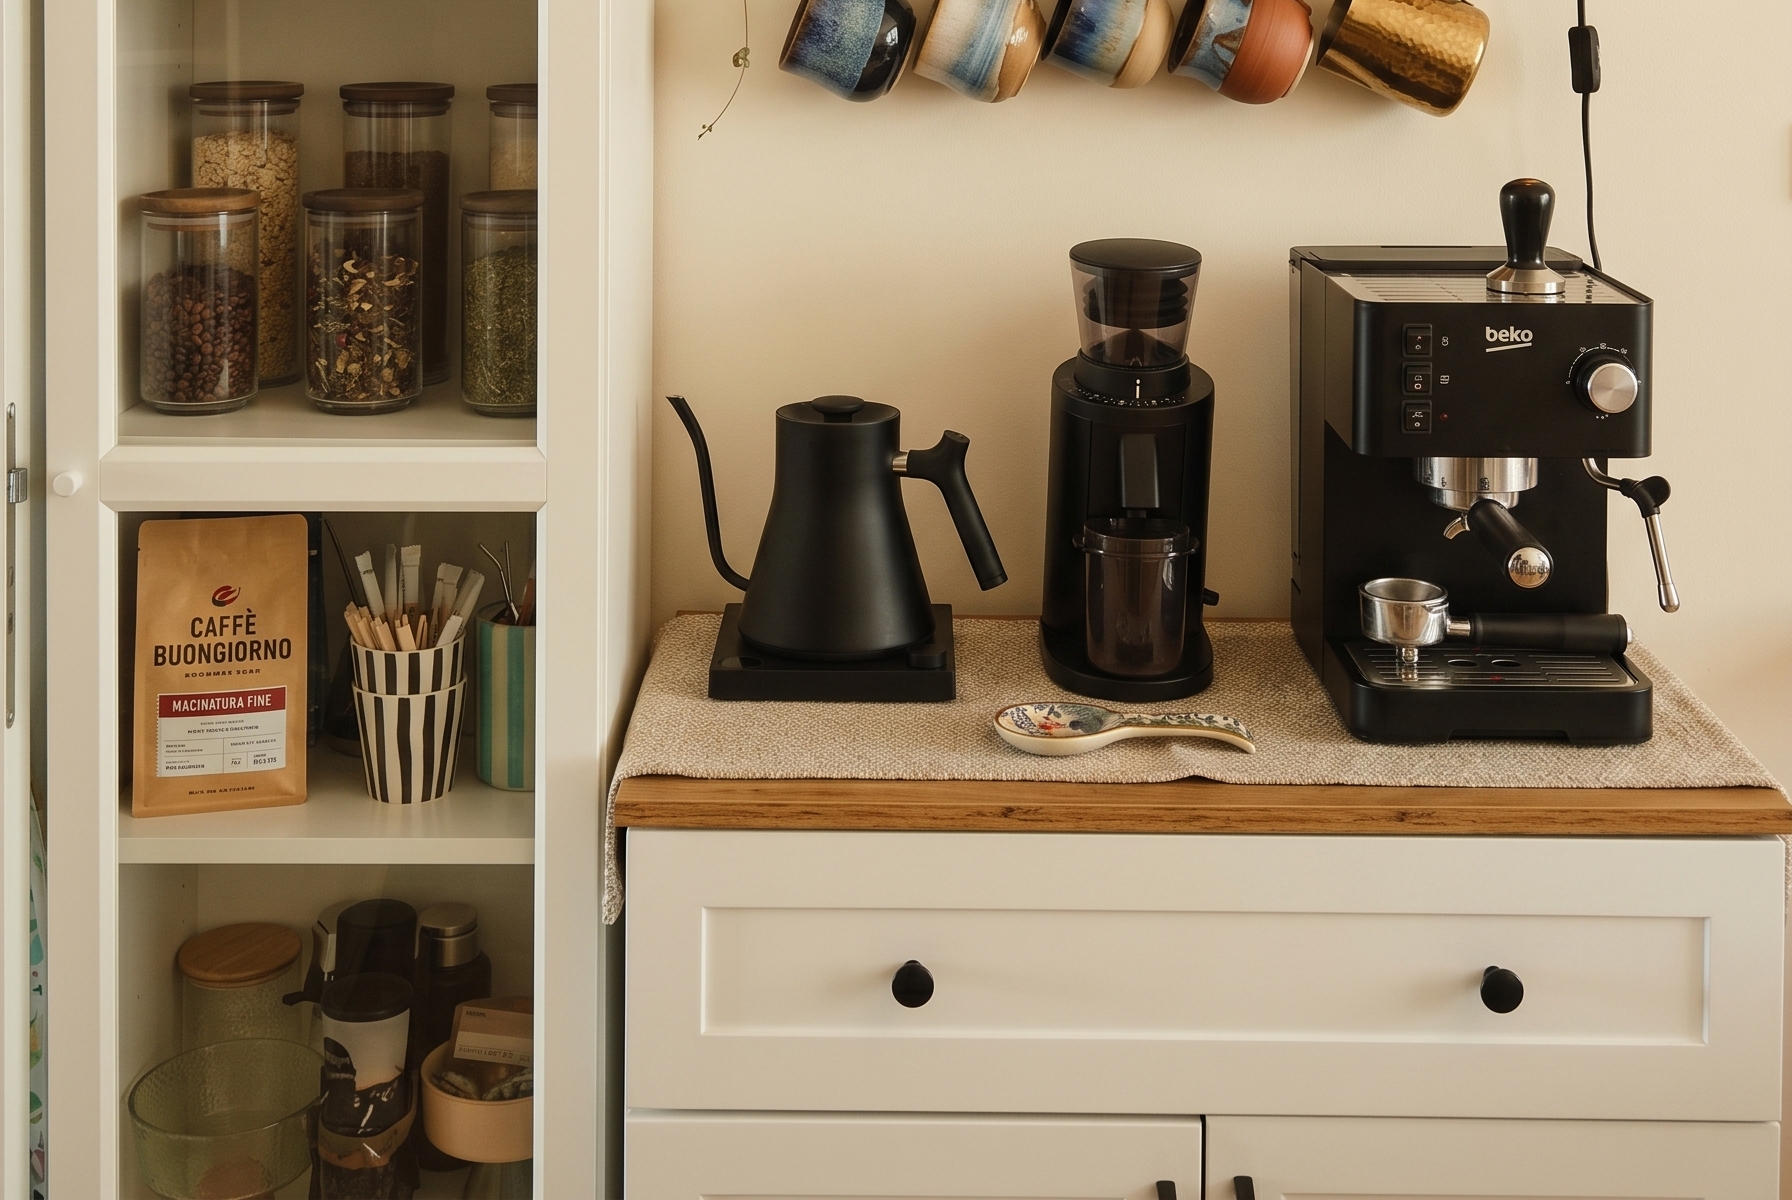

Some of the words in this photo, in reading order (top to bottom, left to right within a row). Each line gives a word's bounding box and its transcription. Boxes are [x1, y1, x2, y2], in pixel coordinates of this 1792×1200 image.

[1485, 325, 1534, 342] beko
[190, 607, 257, 639] CAFFÈ
[154, 637, 292, 667] BUONGIORNO
[172, 696, 245, 712] MACINATURA
[247, 693, 272, 708] FINE
